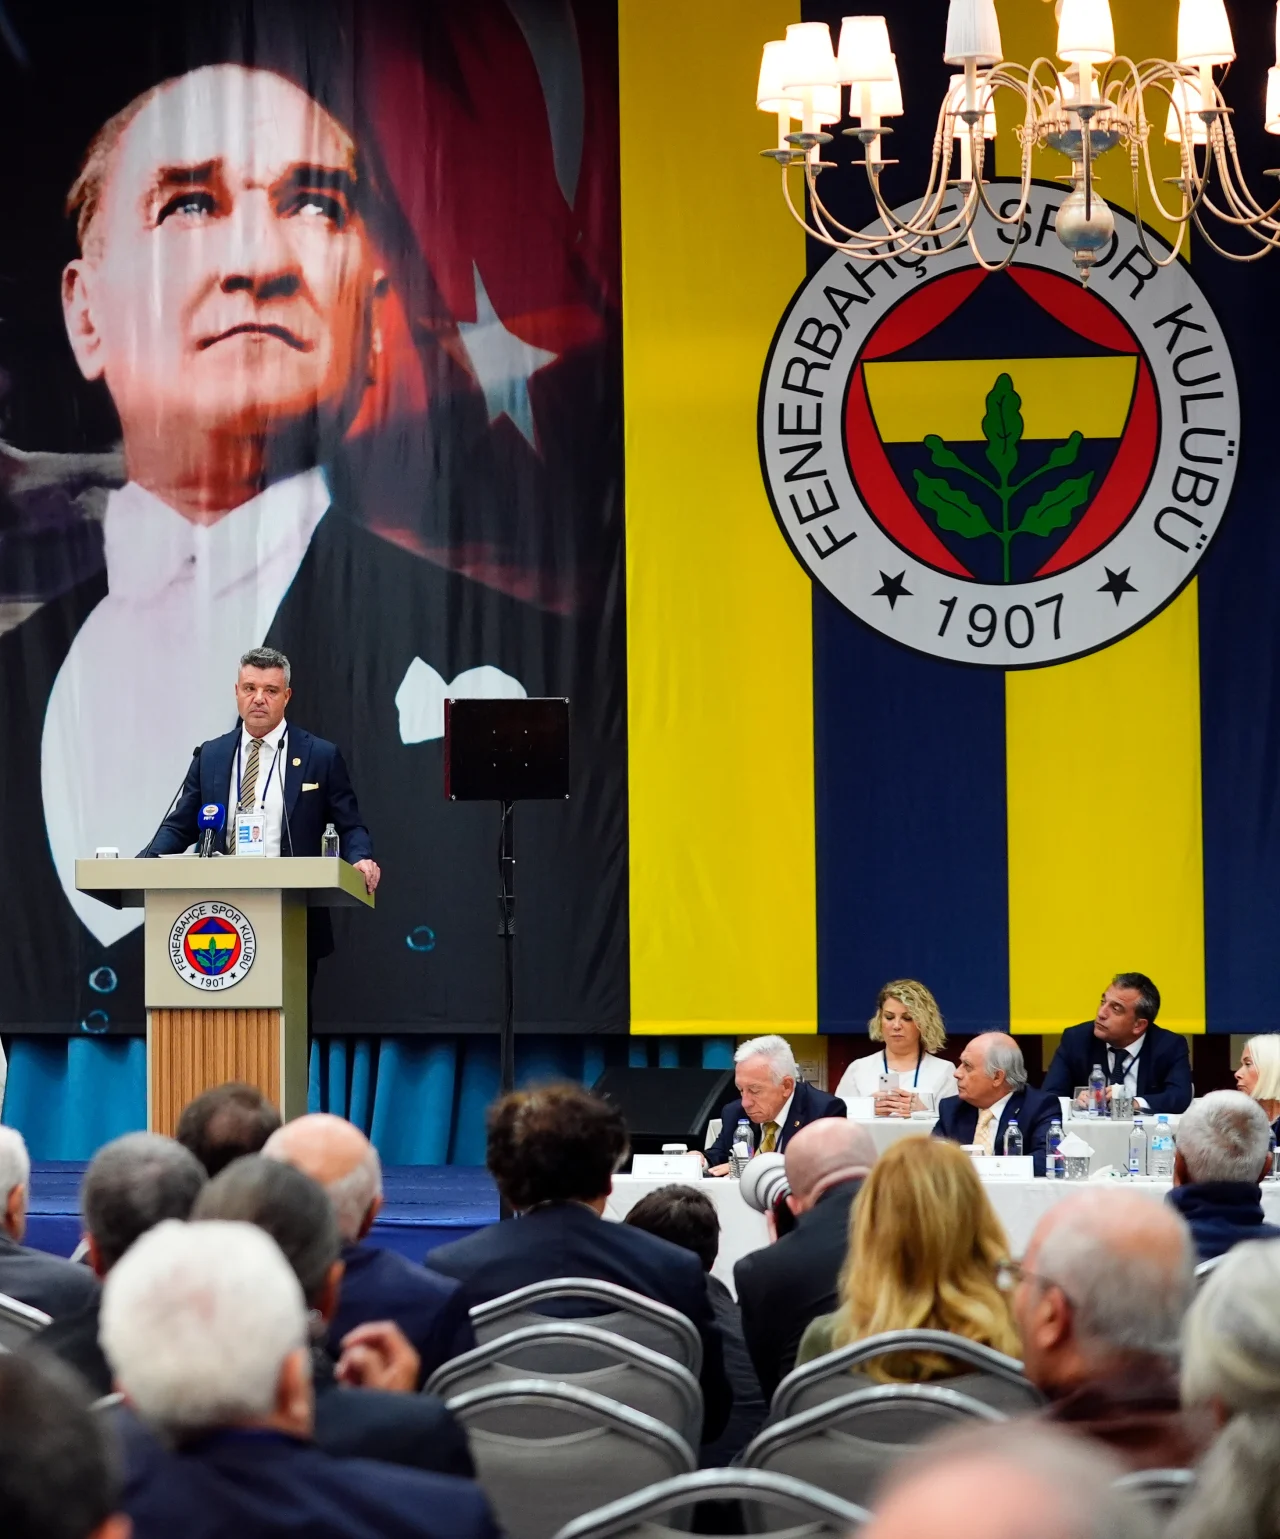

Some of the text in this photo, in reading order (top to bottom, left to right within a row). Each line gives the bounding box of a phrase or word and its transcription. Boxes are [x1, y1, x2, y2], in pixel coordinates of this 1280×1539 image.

[778, 203, 969, 560] FENERBAHÇE
[1153, 303, 1235, 554] KULÜBÜ
[937, 592, 1065, 649] 1907
[171, 904, 255, 971] FENERBAHÇE SPOR KULÜBÜ
[200, 976, 225, 987] 1907
